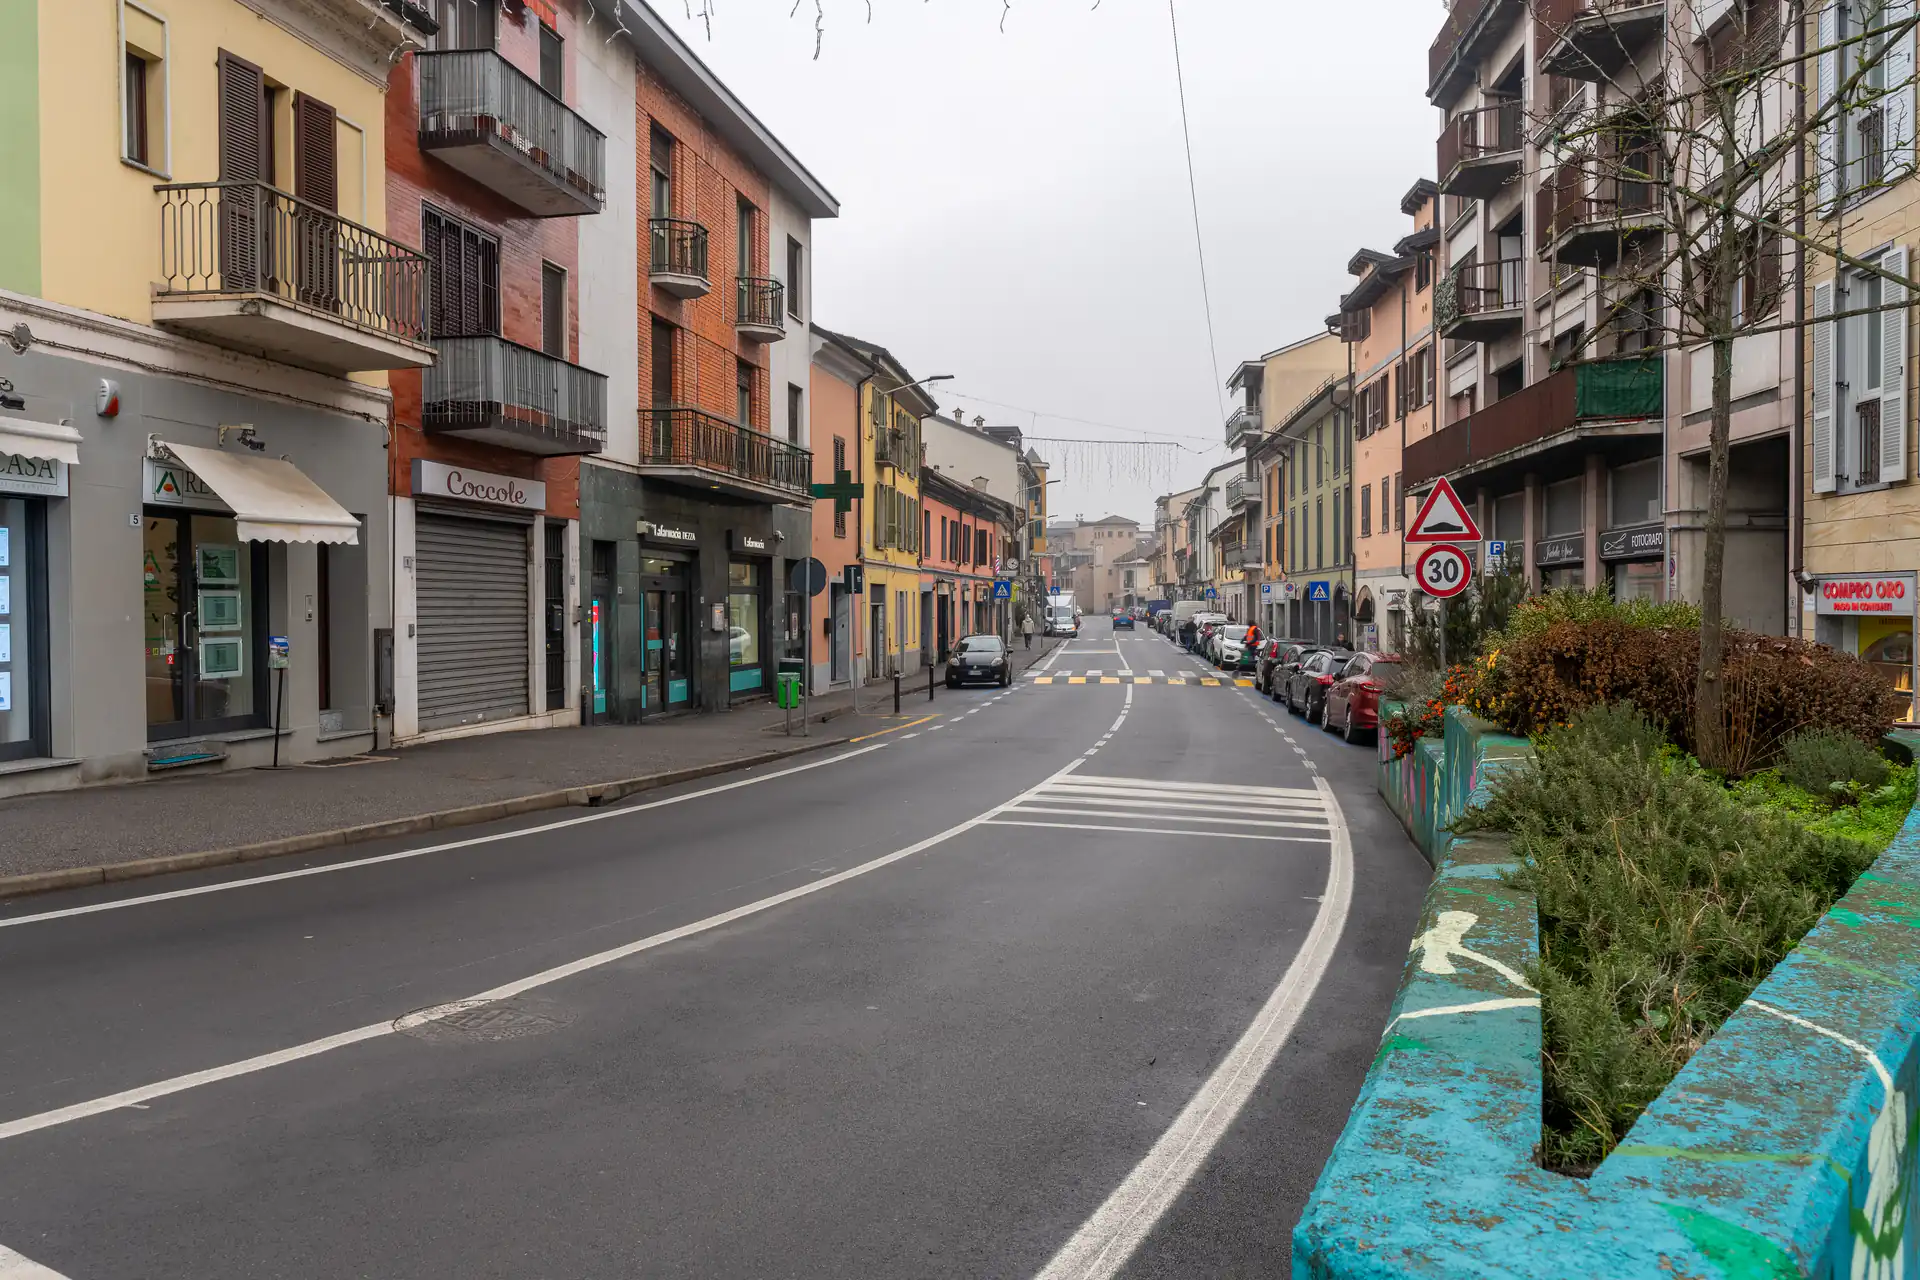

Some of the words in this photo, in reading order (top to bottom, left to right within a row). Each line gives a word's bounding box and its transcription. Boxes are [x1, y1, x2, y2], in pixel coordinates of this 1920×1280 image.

[0, 453, 56, 479] ASA
[446, 471, 527, 505] Coccole
[1631, 531, 1663, 548] FOTOGRAFO
[1428, 558, 1459, 583] 30
[1823, 581, 1873, 599] COMPRO
[1875, 580, 1905, 599] ORO
